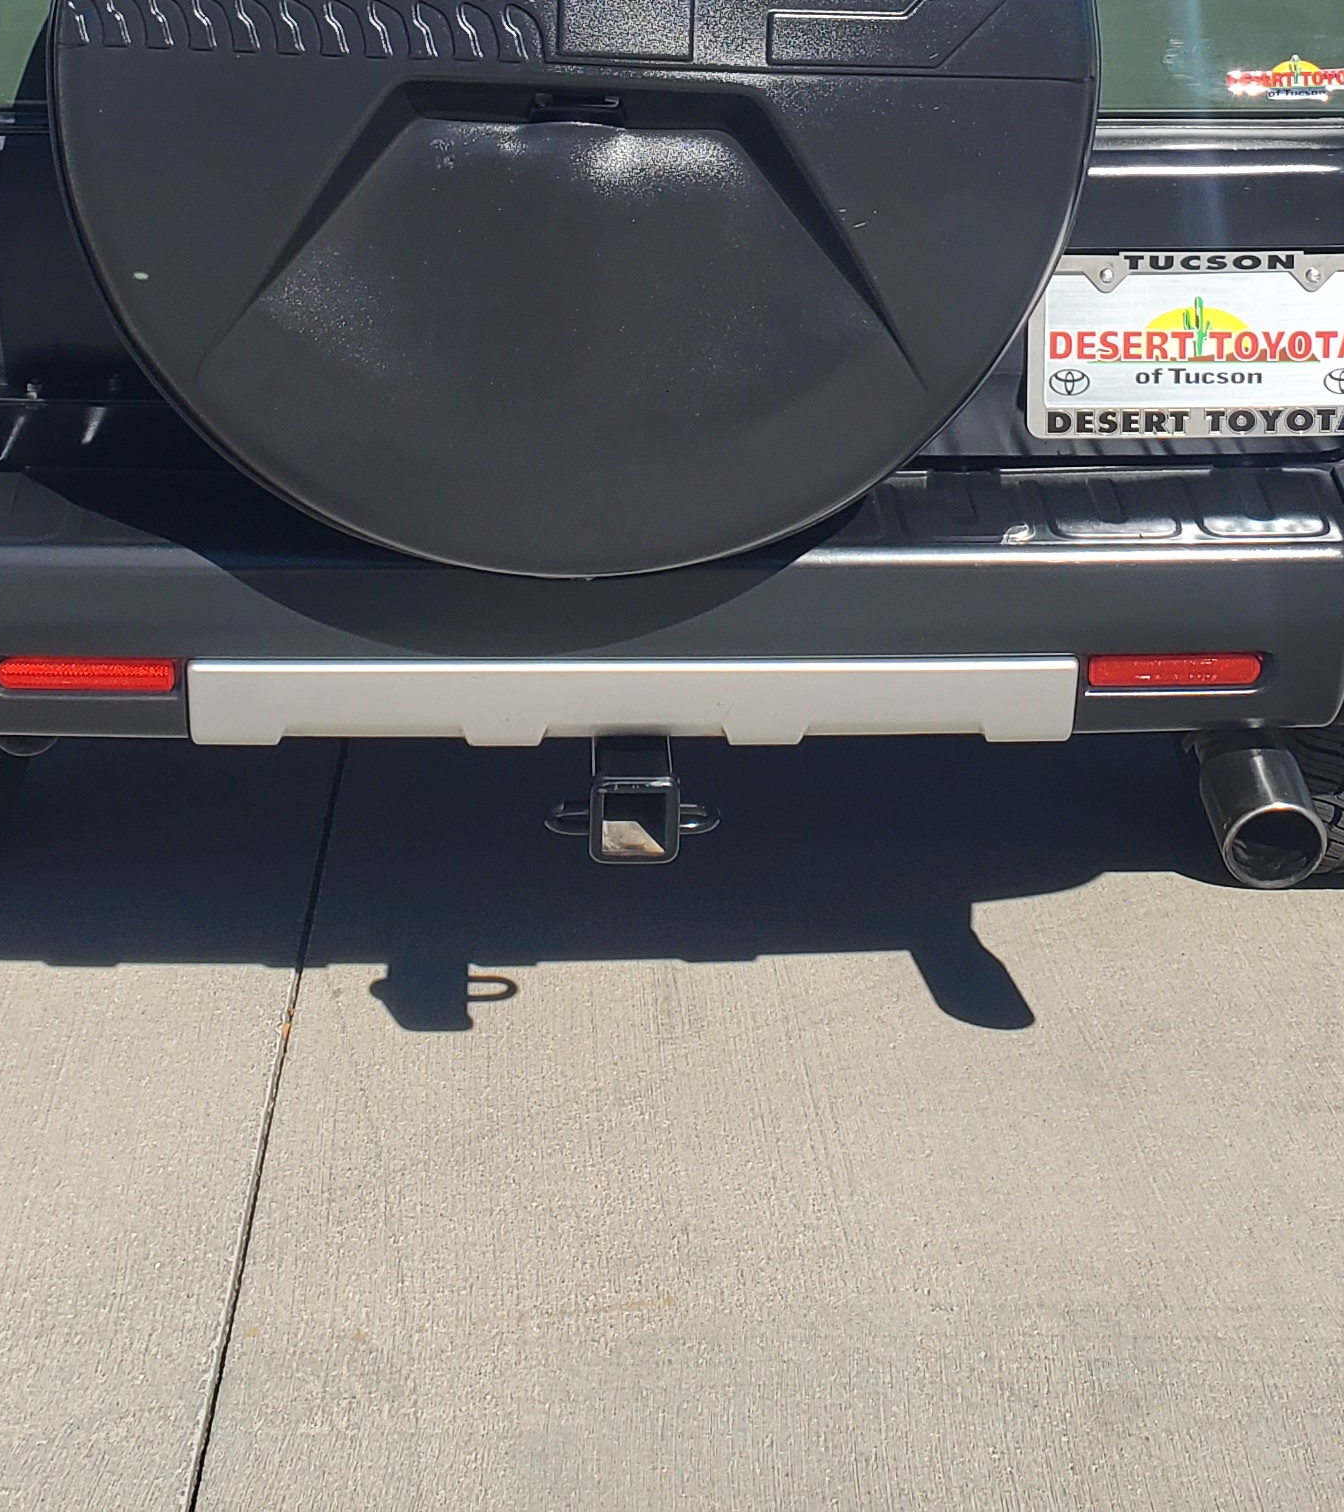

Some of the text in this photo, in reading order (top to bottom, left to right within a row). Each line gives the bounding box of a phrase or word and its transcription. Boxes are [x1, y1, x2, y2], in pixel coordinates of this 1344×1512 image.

[1226, 71, 1293, 87] DESERT
[1268, 89, 1326, 98] of Tucson
[1123, 255, 1296, 271] TUCSON
[1048, 331, 1194, 361] DESERT
[1135, 368, 1263, 385] of Tucson
[1046, 408, 1190, 435] DESERT
